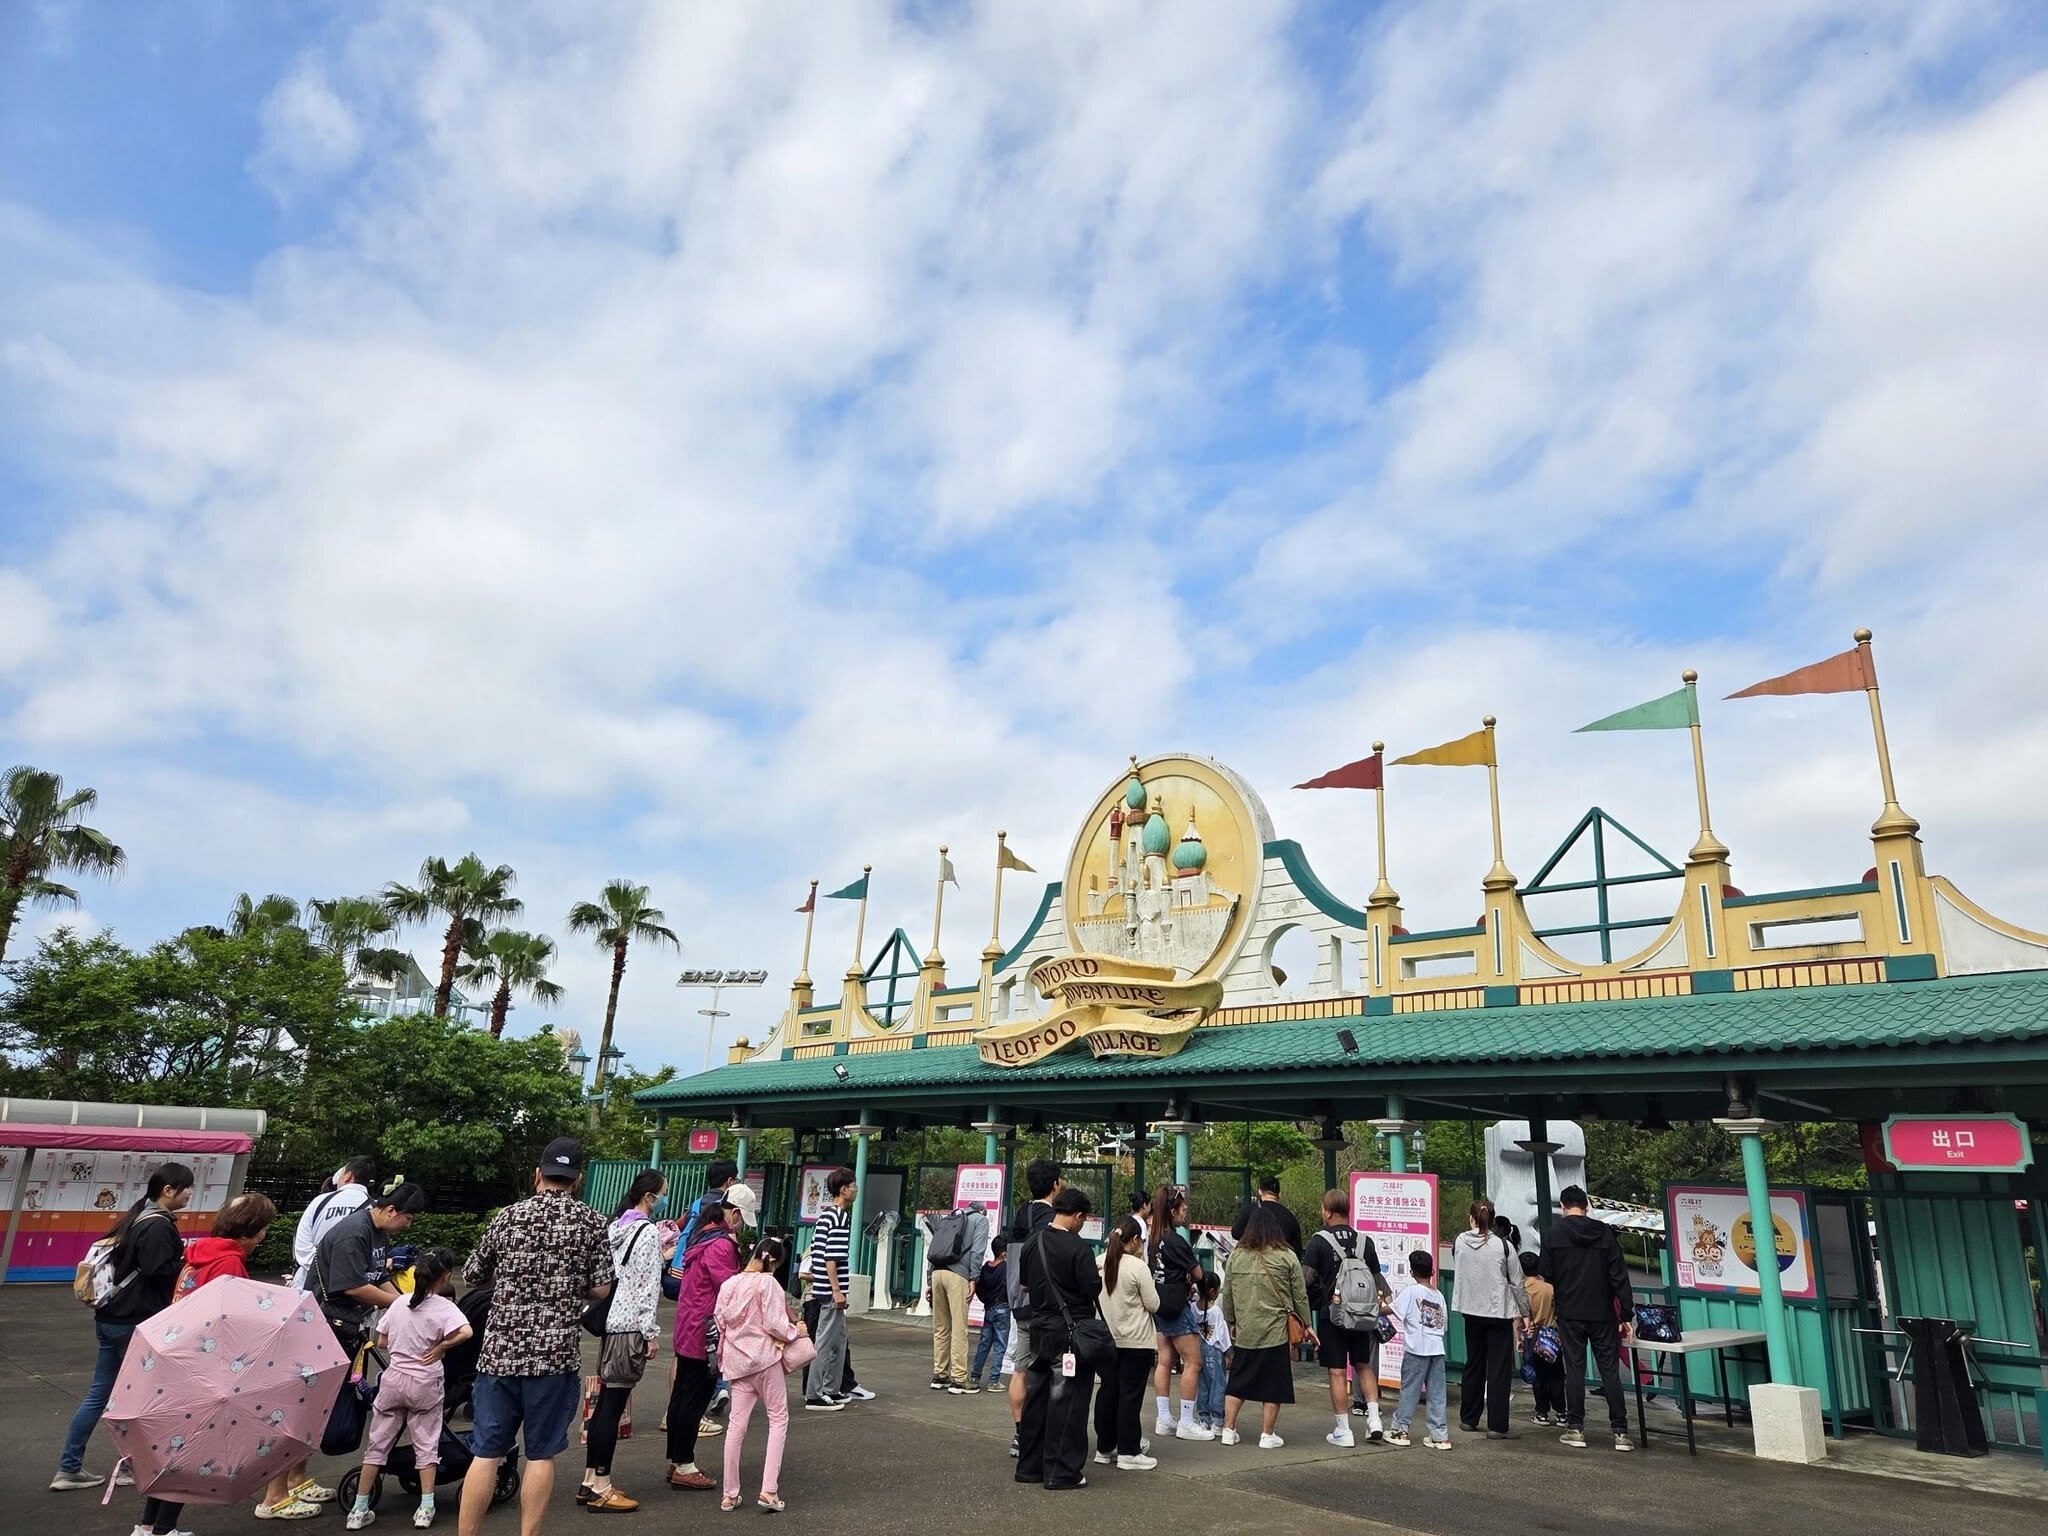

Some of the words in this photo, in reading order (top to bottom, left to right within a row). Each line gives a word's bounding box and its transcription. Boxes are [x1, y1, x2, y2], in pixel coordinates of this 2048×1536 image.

[1033, 958, 1099, 989] WORLD
[981, 1044, 990, 1058] AT
[991, 1020, 1077, 1063] LEOFOO
[1086, 1032, 1161, 1058] VILLAGE
[1932, 1129, 1975, 1148] 出口
[1946, 1150, 1964, 1158] Exit
[1359, 1195, 1426, 1208] 公共安全措施公告
